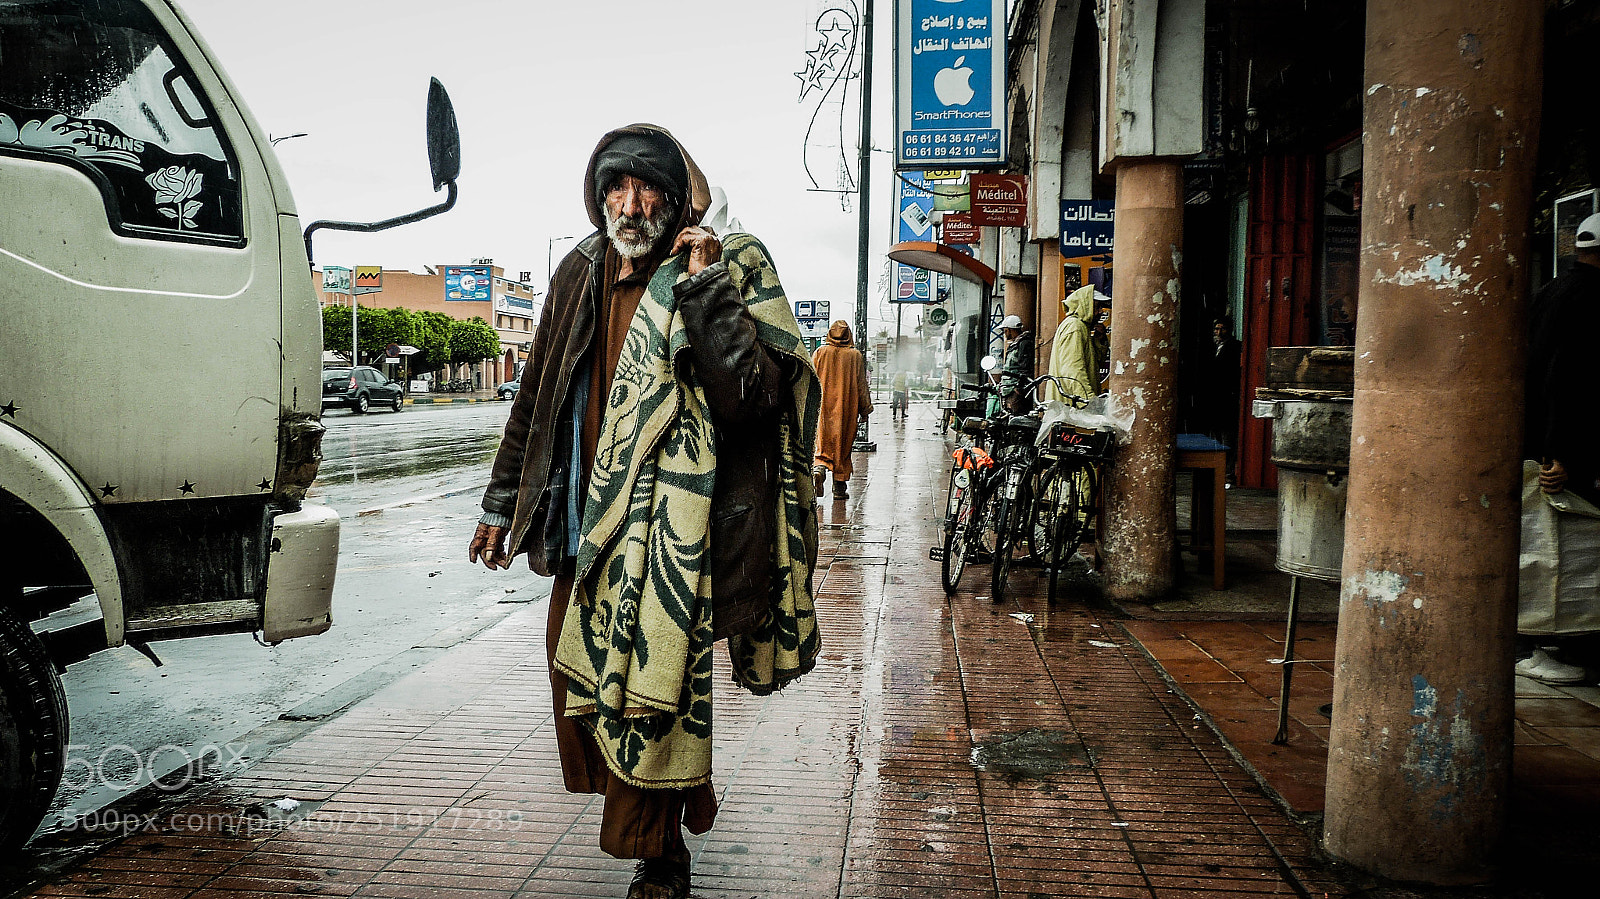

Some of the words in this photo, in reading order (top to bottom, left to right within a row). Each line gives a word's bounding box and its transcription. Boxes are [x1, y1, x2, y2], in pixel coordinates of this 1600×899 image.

[921, 14, 954, 31] إصلاح
[956, 16, 964, 30] و
[967, 16, 988, 30] بيع
[913, 38, 949, 55] النقال
[951, 37, 992, 50] الهاتف
[914, 110, 992, 121] SmartPhones
[88, 129, 145, 153] TRANS
[905, 134, 918, 144] 06
[920, 134, 932, 144] 61
[934, 134, 947, 143] 84
[949, 133, 962, 143] 36
[963, 133, 976, 143] 47
[905, 147, 918, 157] 06
[920, 147, 932, 156] 61
[934, 147, 947, 156] 89
[948, 147, 961, 156] 42
[963, 146, 976, 156] 10
[976, 189, 1017, 200] Méditel
[1008, 206, 1019, 214] هنا
[1063, 205, 1115, 221] تصالات
[1063, 230, 1092, 250] باها
